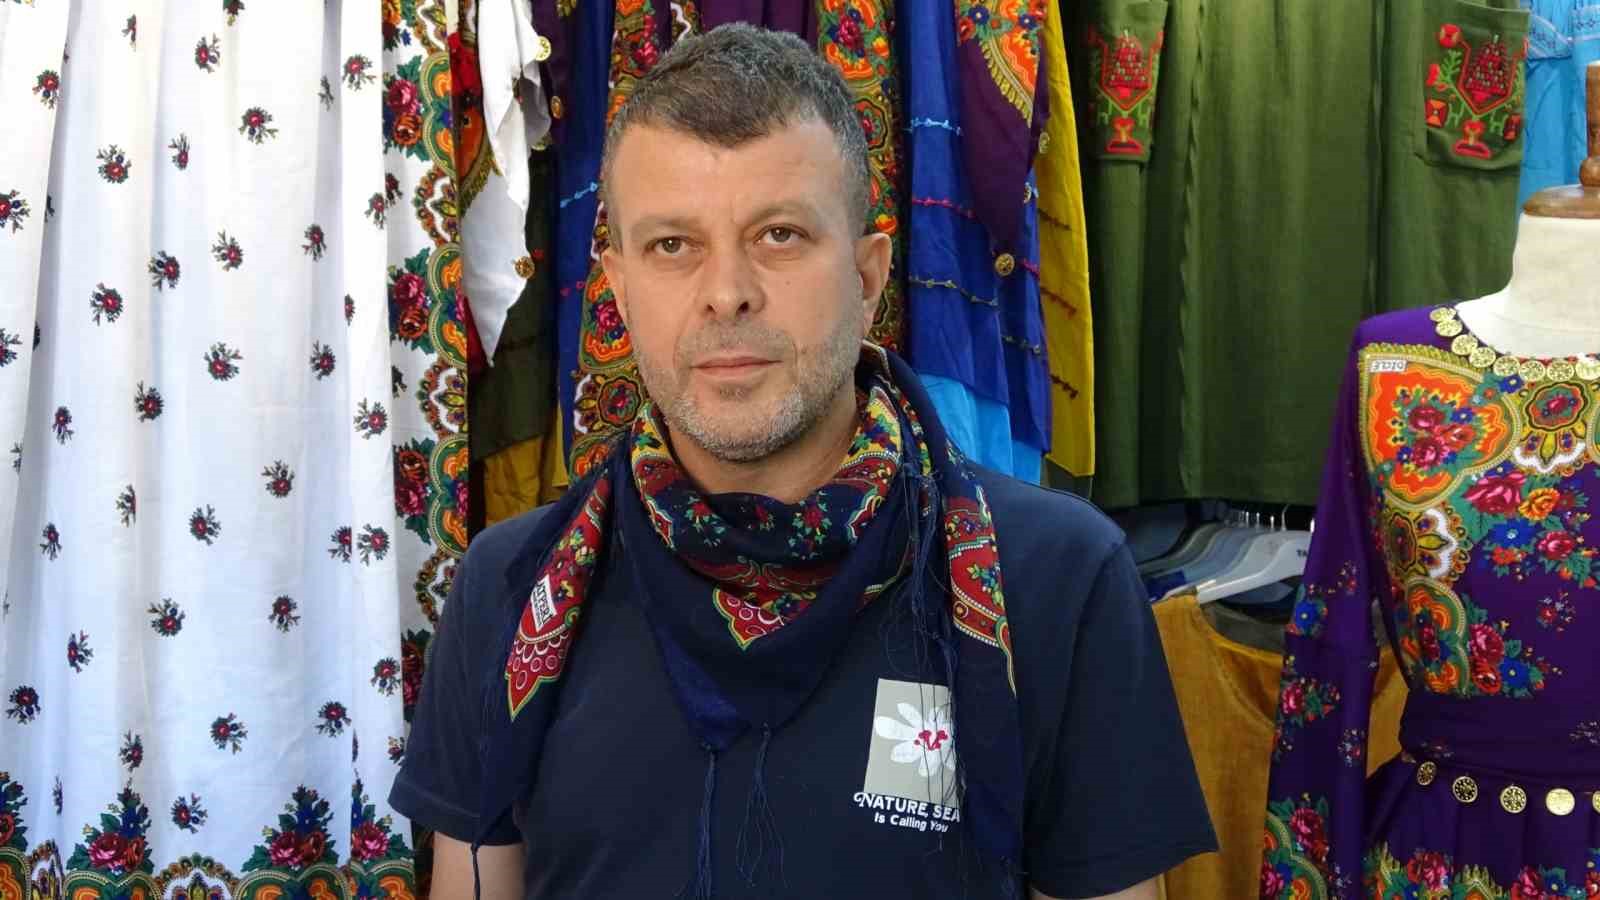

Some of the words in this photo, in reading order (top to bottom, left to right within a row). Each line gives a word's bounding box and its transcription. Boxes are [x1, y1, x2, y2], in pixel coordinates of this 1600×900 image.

[874, 811, 886, 824] Is
[890, 814, 927, 832] Calling
[930, 820, 949, 833] You
[932, 804, 961, 823] SEA
